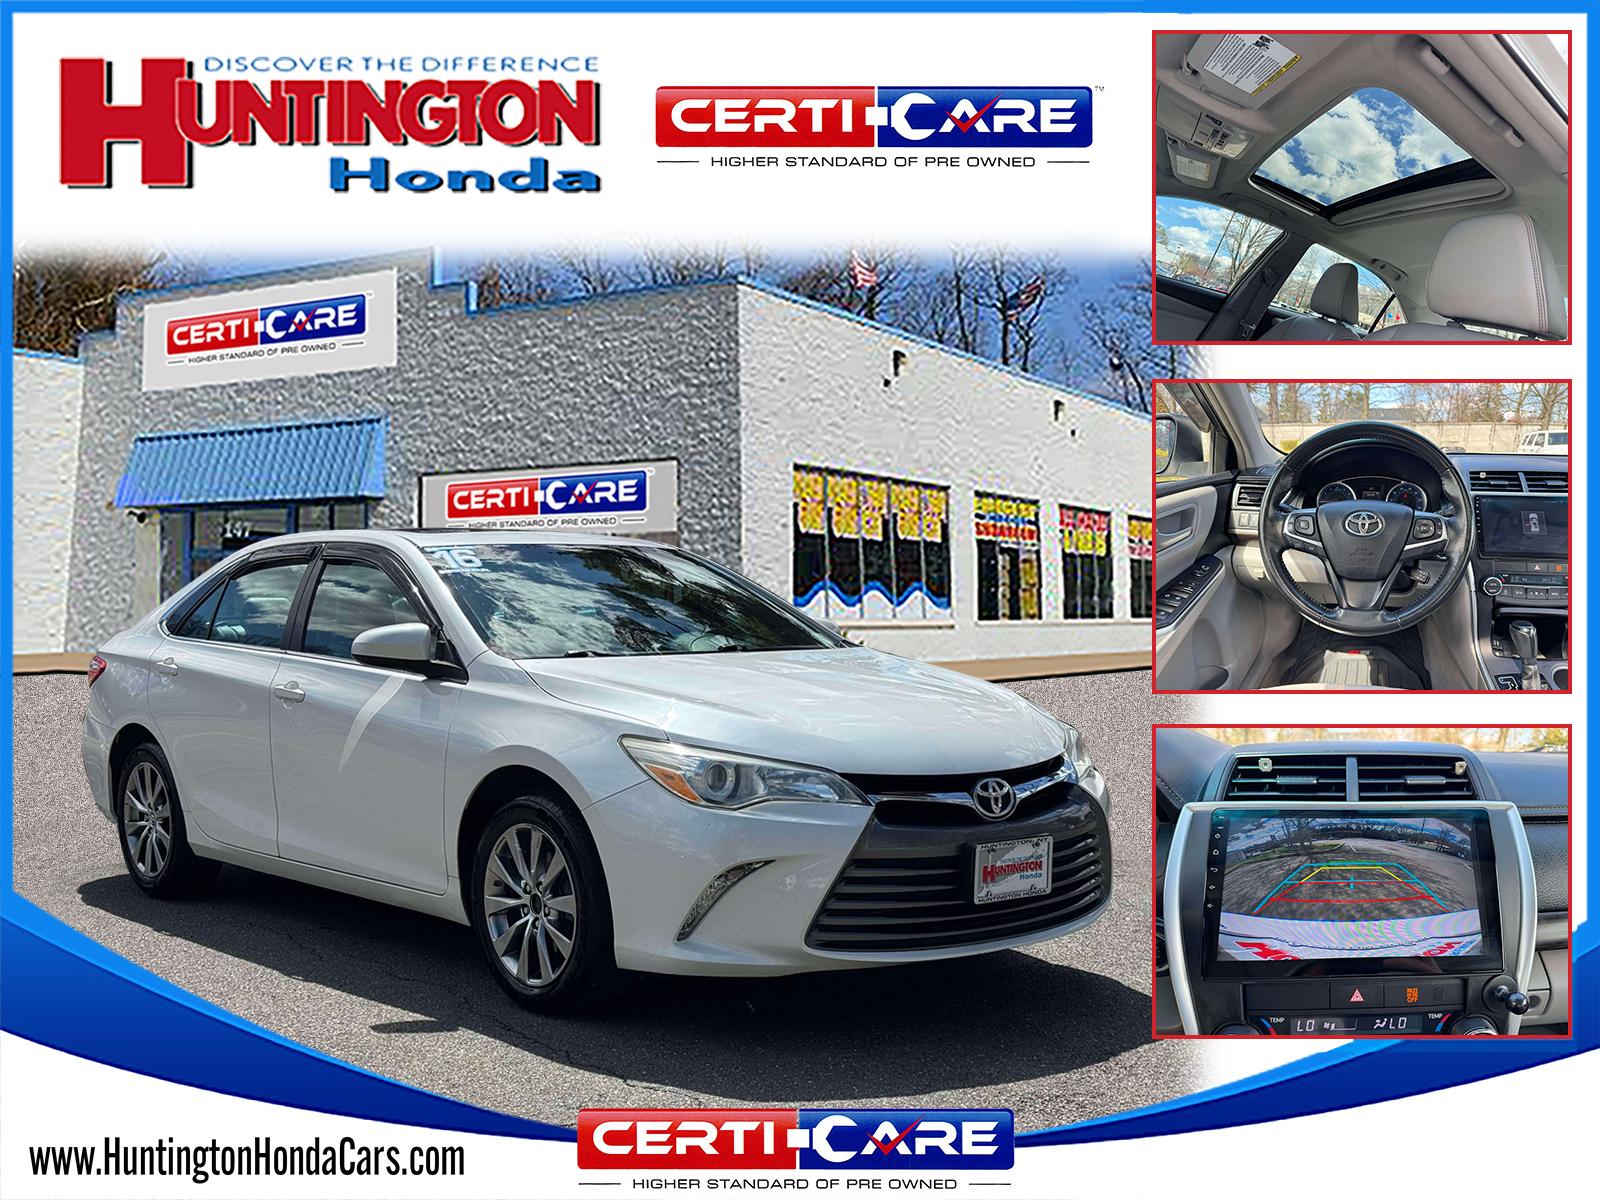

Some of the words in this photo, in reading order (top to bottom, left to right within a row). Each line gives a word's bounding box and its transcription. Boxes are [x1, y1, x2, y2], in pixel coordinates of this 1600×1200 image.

[188, 353, 218, 365] HIGHER
[219, 349, 265, 362] STANDARD
[267, 347, 279, 357] OF
[281, 345, 299, 355] PRE
[301, 342, 337, 353] OWNED
[468, 521, 498, 529] HIGHER
[499, 520, 545, 529] STANDARD
[547, 519, 559, 527] OF
[561, 518, 579, 527] PRE
[581, 516, 617, 526] OWNED
[982, 860, 1043, 883] HUNTINGTON
[1019, 871, 1043, 881] Honda
[1270, 1016, 1285, 1024] TEMP
[1296, 1019, 1315, 1032] LO
[1389, 1017, 1408, 1030] LO
